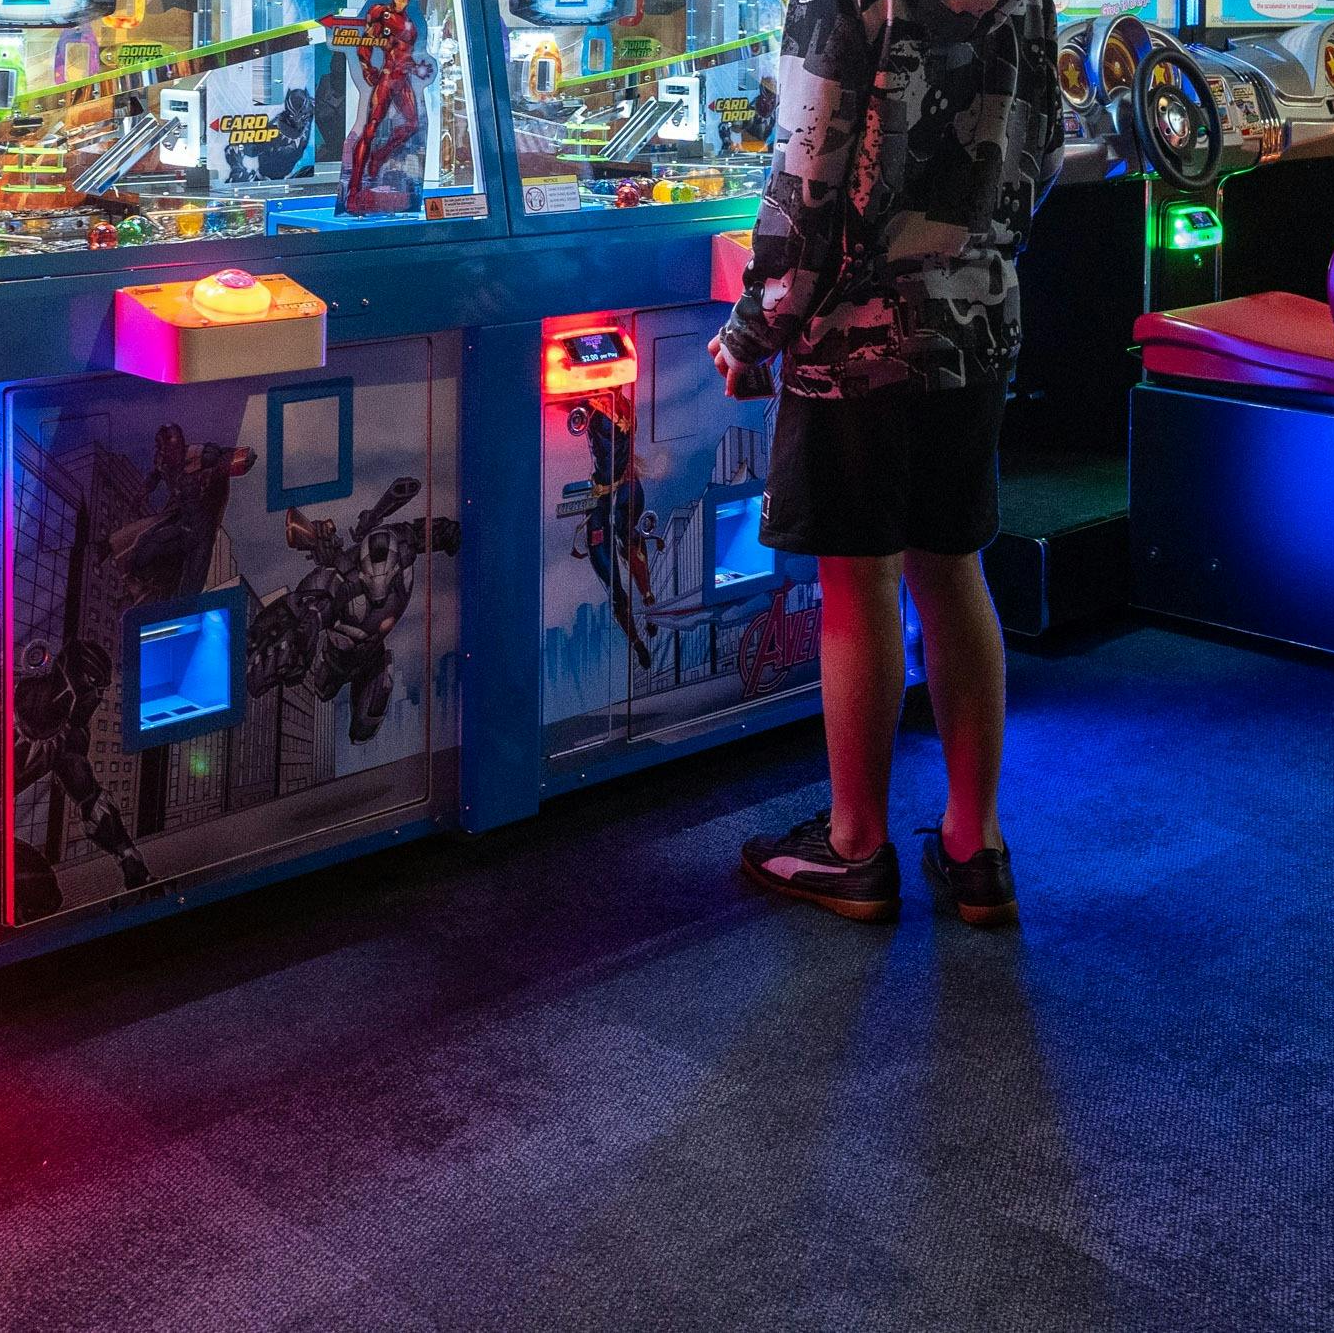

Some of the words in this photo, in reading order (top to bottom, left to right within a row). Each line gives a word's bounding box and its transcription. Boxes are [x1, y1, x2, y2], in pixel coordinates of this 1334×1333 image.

[340, 29, 357, 38] am
[333, 36, 360, 46] IRON
[359, 37, 388, 47] MAN
[121, 45, 162, 57] BONUS
[716, 98, 749, 111] CARD
[220, 115, 268, 130] CARD
[722, 110, 755, 123] DROP
[229, 129, 279, 144] DROP
[581, 353, 599, 363] $2.00
